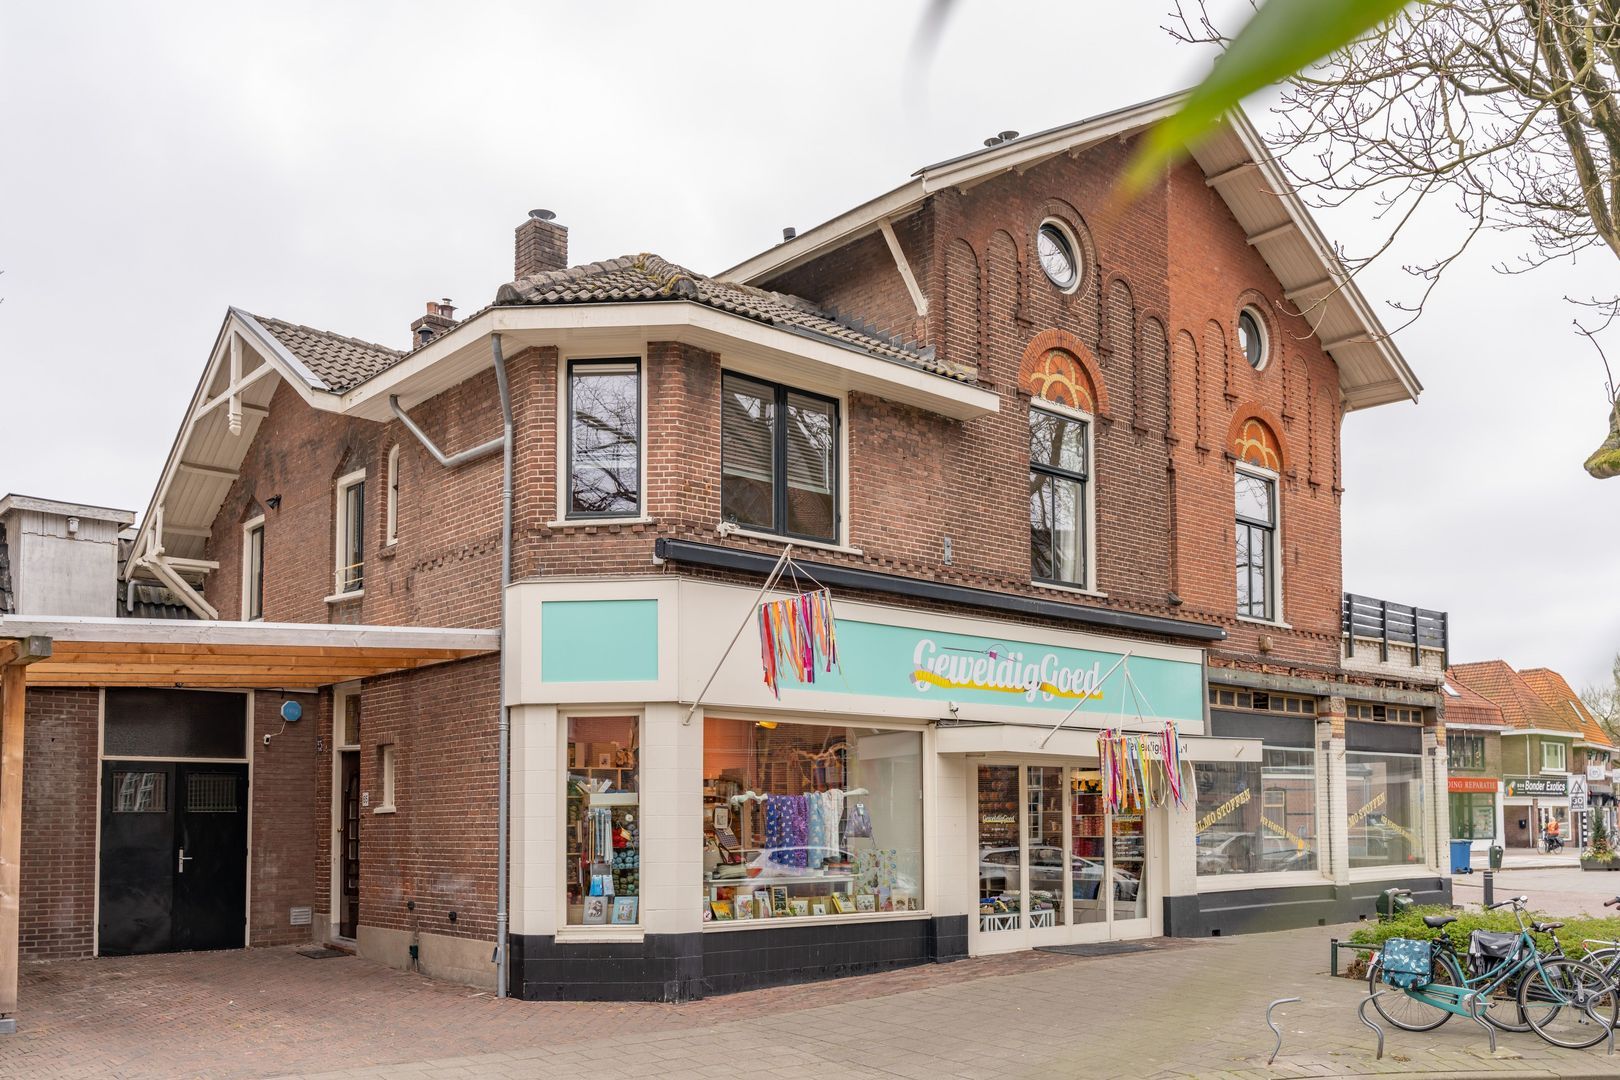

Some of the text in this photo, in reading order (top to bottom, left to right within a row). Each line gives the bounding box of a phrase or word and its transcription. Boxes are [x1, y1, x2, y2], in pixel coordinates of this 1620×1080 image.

[913, 639, 1102, 703] GeweldigGoed
[1525, 780, 1545, 791] Bonder
[1546, 781, 1566, 792] Exotics
[1216, 788, 1251, 820] STOFFEN
[1572, 797, 1584, 805] 30
